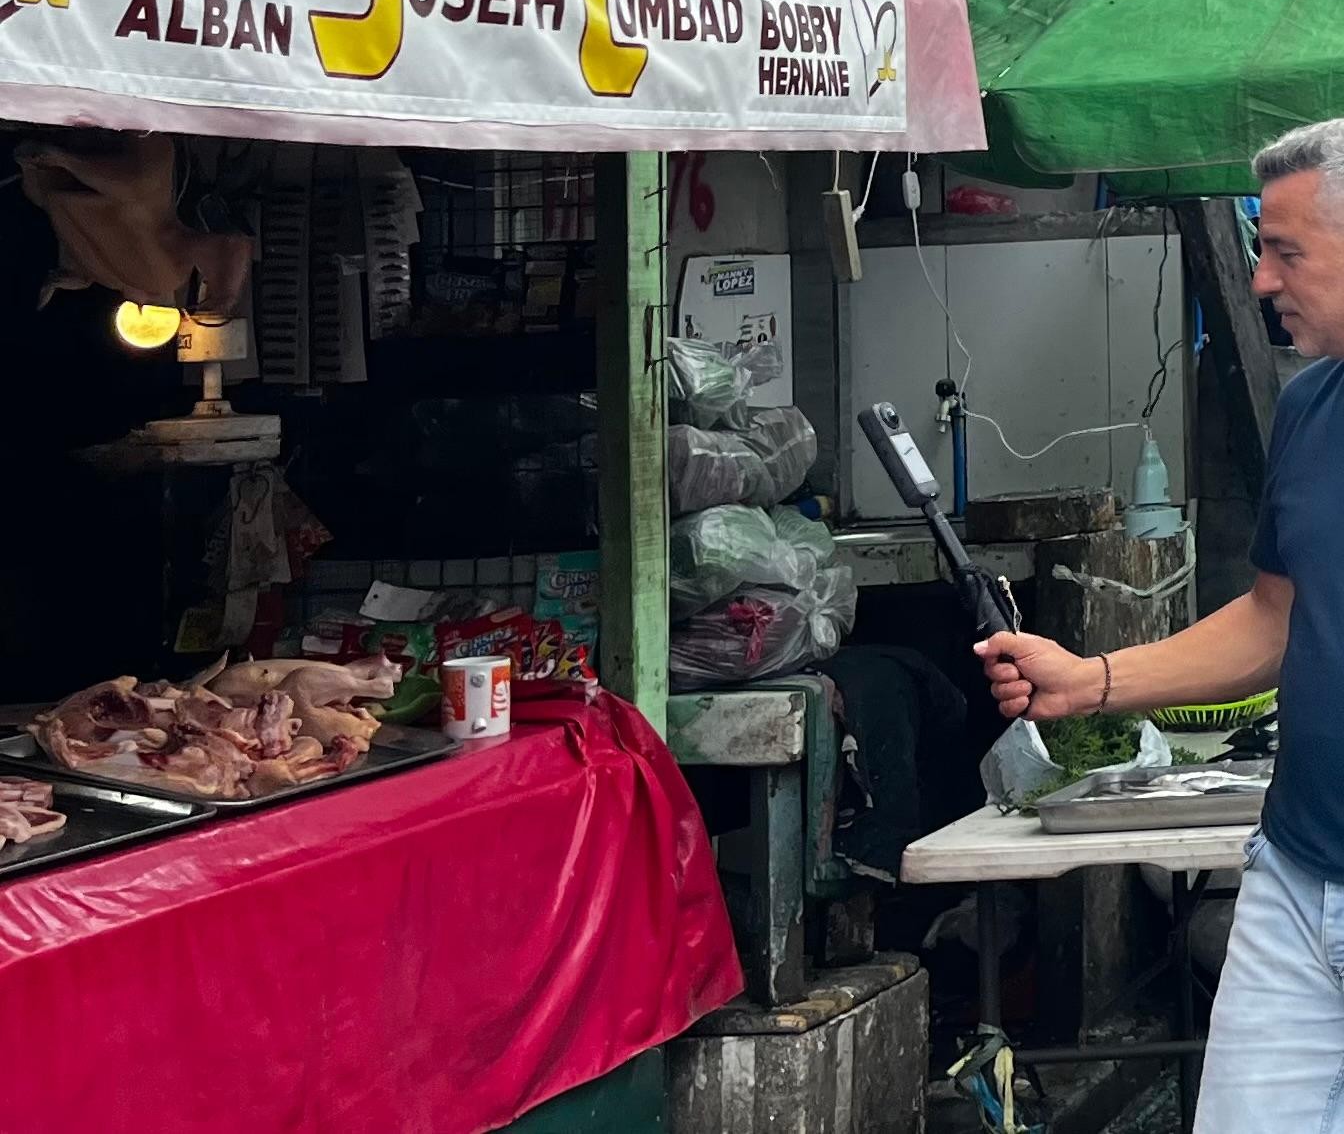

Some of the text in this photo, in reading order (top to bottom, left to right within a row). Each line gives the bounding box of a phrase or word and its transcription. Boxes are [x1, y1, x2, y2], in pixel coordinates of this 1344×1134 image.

[760, 0, 842, 55] BOBBY
[758, 56, 850, 97] HERNANE
[715, 274, 754, 292] LOPEZ
